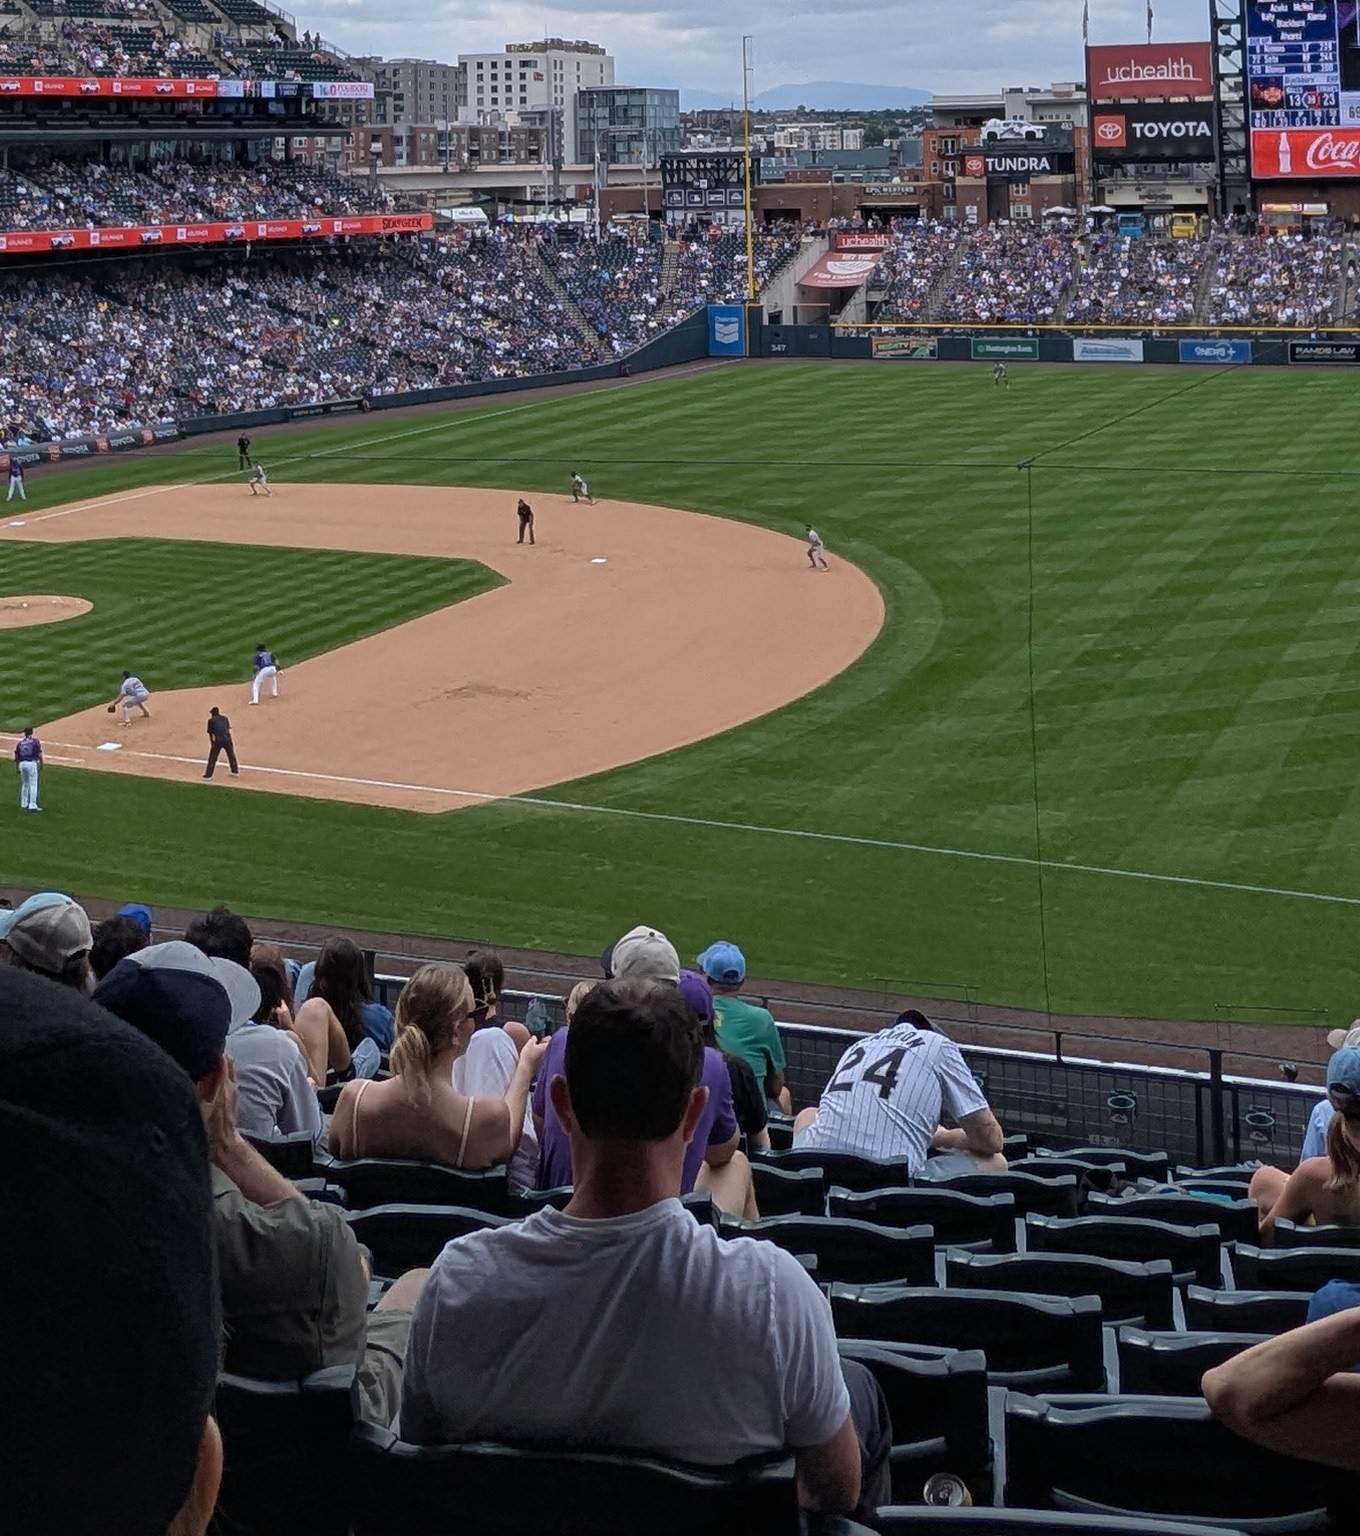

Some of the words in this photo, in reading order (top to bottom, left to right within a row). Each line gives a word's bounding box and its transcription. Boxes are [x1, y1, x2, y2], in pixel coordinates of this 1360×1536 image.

[1107, 57, 1193, 81] uchealth
[1289, 95, 1301, 106] 13
[1322, 93, 1335, 106] 23
[1131, 121, 1211, 138] TOYOTA
[985, 157, 1051, 172] TUNDRA
[842, 234, 889, 246] uchealth
[827, 1047, 907, 1100] 24
